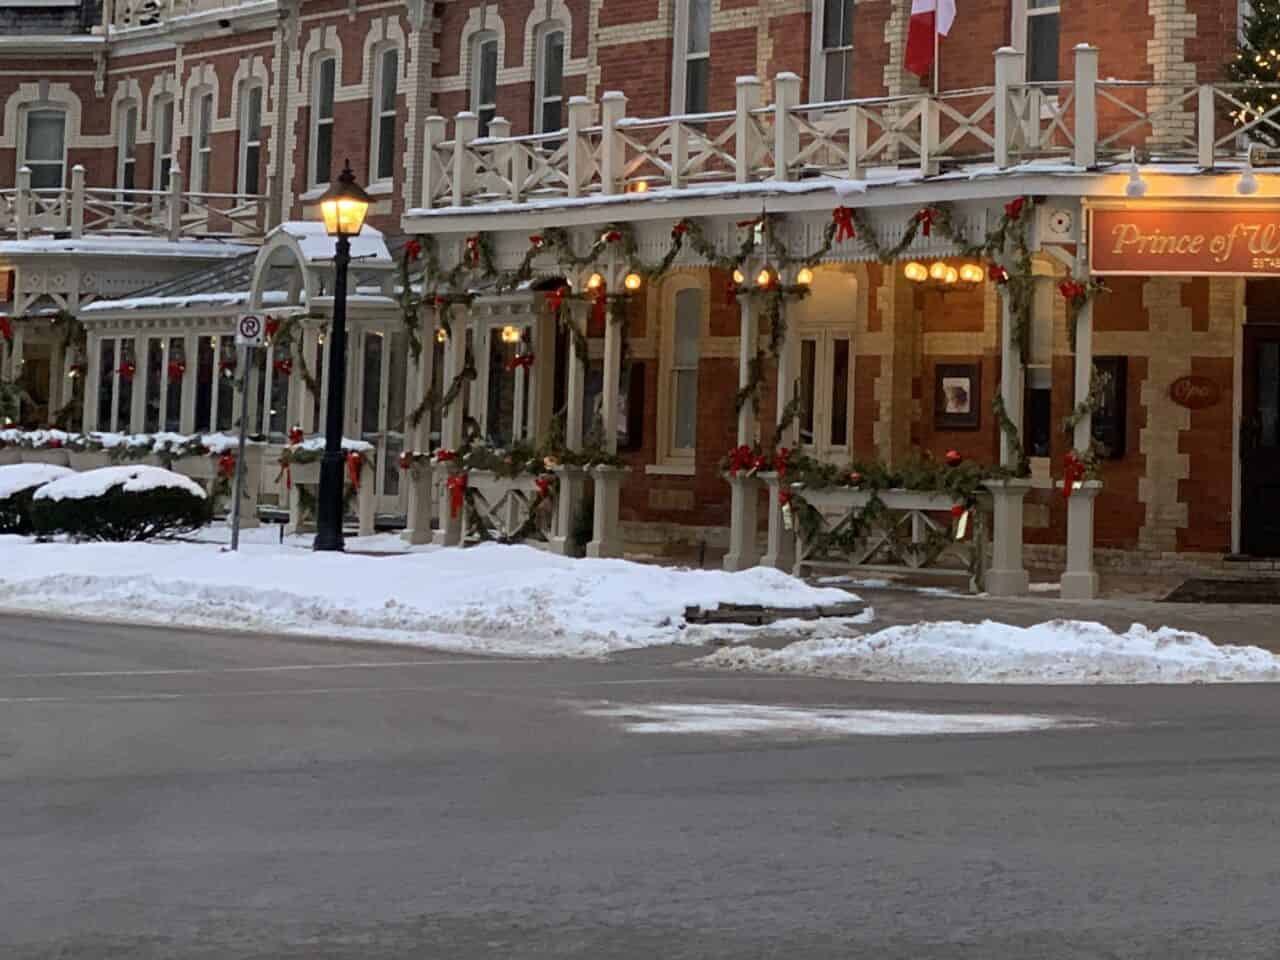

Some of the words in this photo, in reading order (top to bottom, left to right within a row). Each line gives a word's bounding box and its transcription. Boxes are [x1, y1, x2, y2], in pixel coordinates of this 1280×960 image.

[1111, 223, 1205, 254] Prince
[1209, 223, 1245, 262] of
[1175, 378, 1215, 401] Ope
